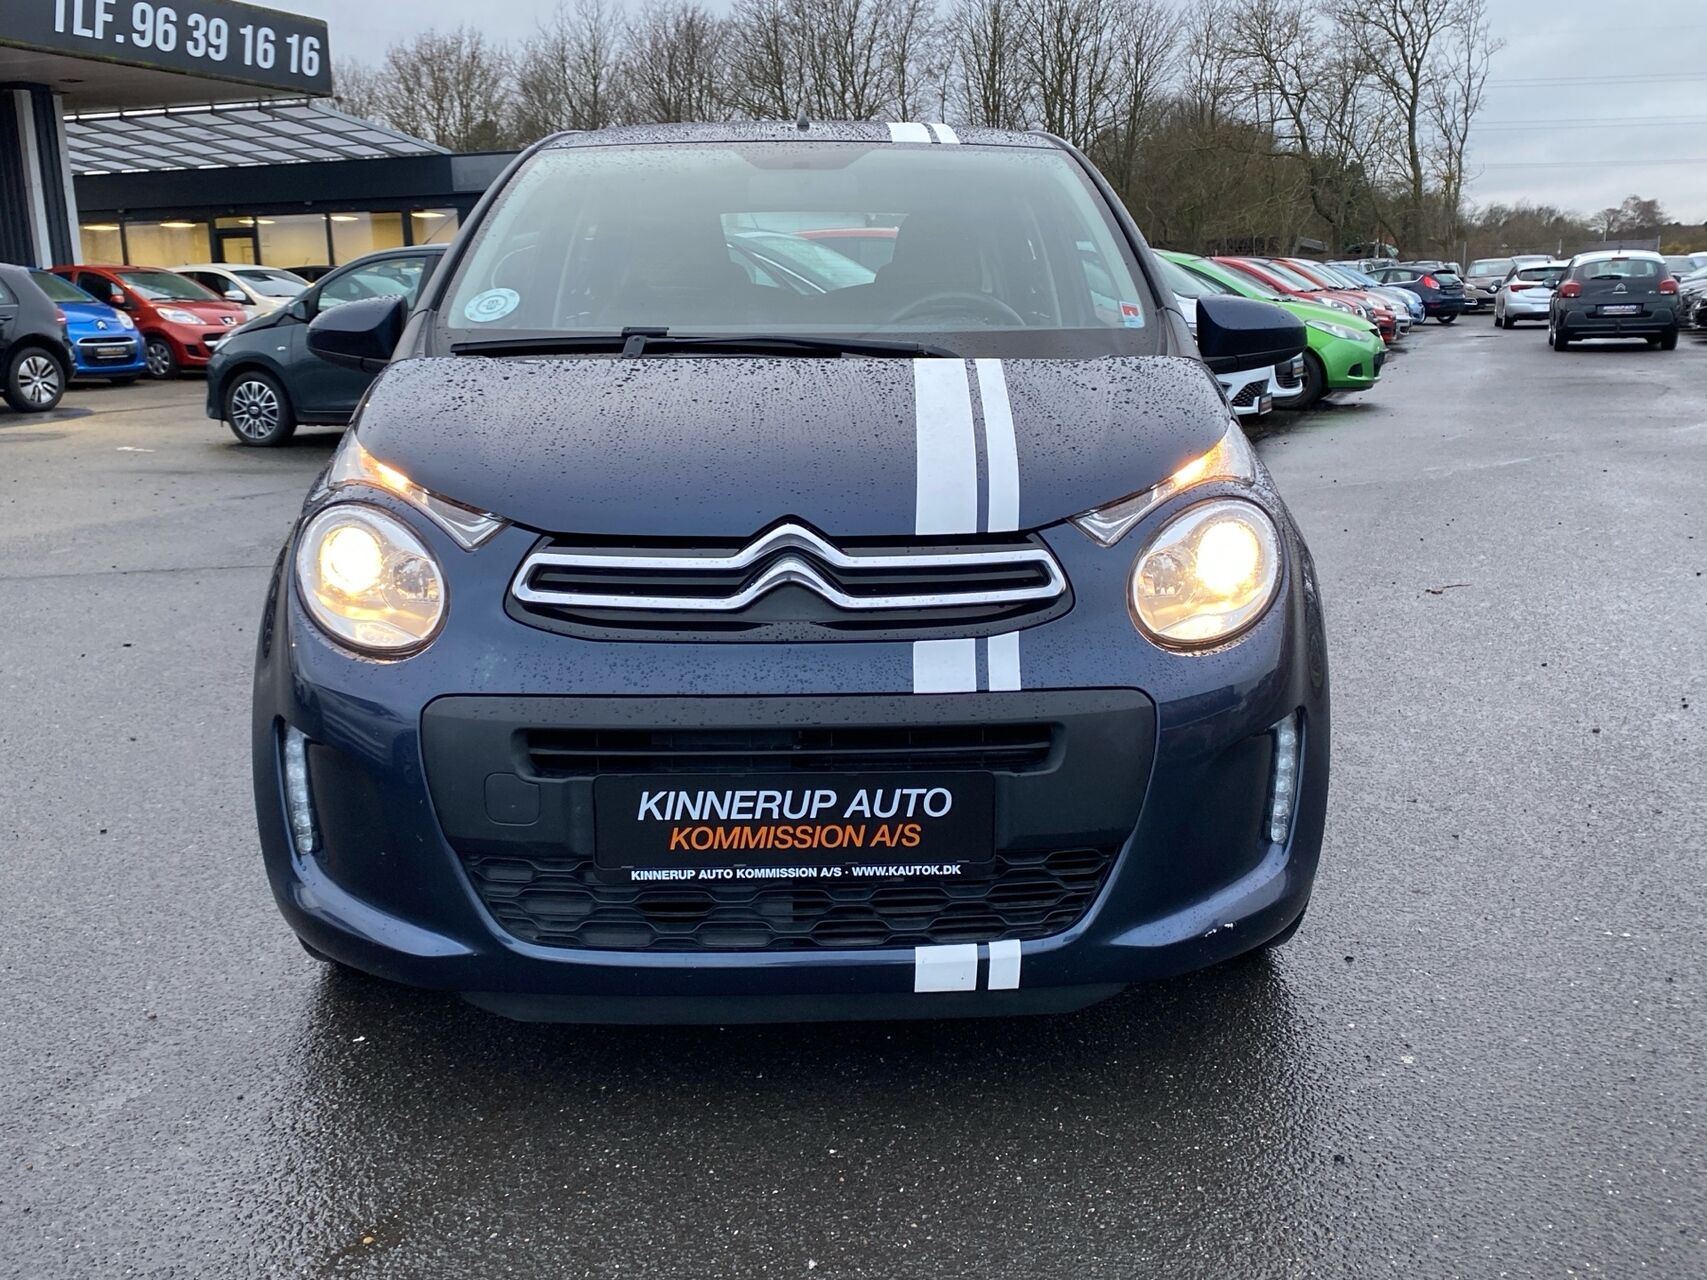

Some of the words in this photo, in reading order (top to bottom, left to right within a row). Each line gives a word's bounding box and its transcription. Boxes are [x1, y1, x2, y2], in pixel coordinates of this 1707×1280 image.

[132, 2, 177, 52] 96
[186, 13, 229, 61] 39
[240, 25, 276, 69] 16
[286, 34, 320, 77] 16
[637, 789, 838, 821] KINNERUP
[842, 787, 953, 819] AUTO
[669, 824, 866, 850] KOMMISSION
[870, 823, 922, 847] A/S
[631, 869, 696, 881] KINNERUP
[699, 868, 734, 880] AUTO
[736, 867, 818, 879] KOMMISSION
[820, 866, 842, 878] A/S
[851, 864, 962, 878] WWW.KAUTOK.DK
